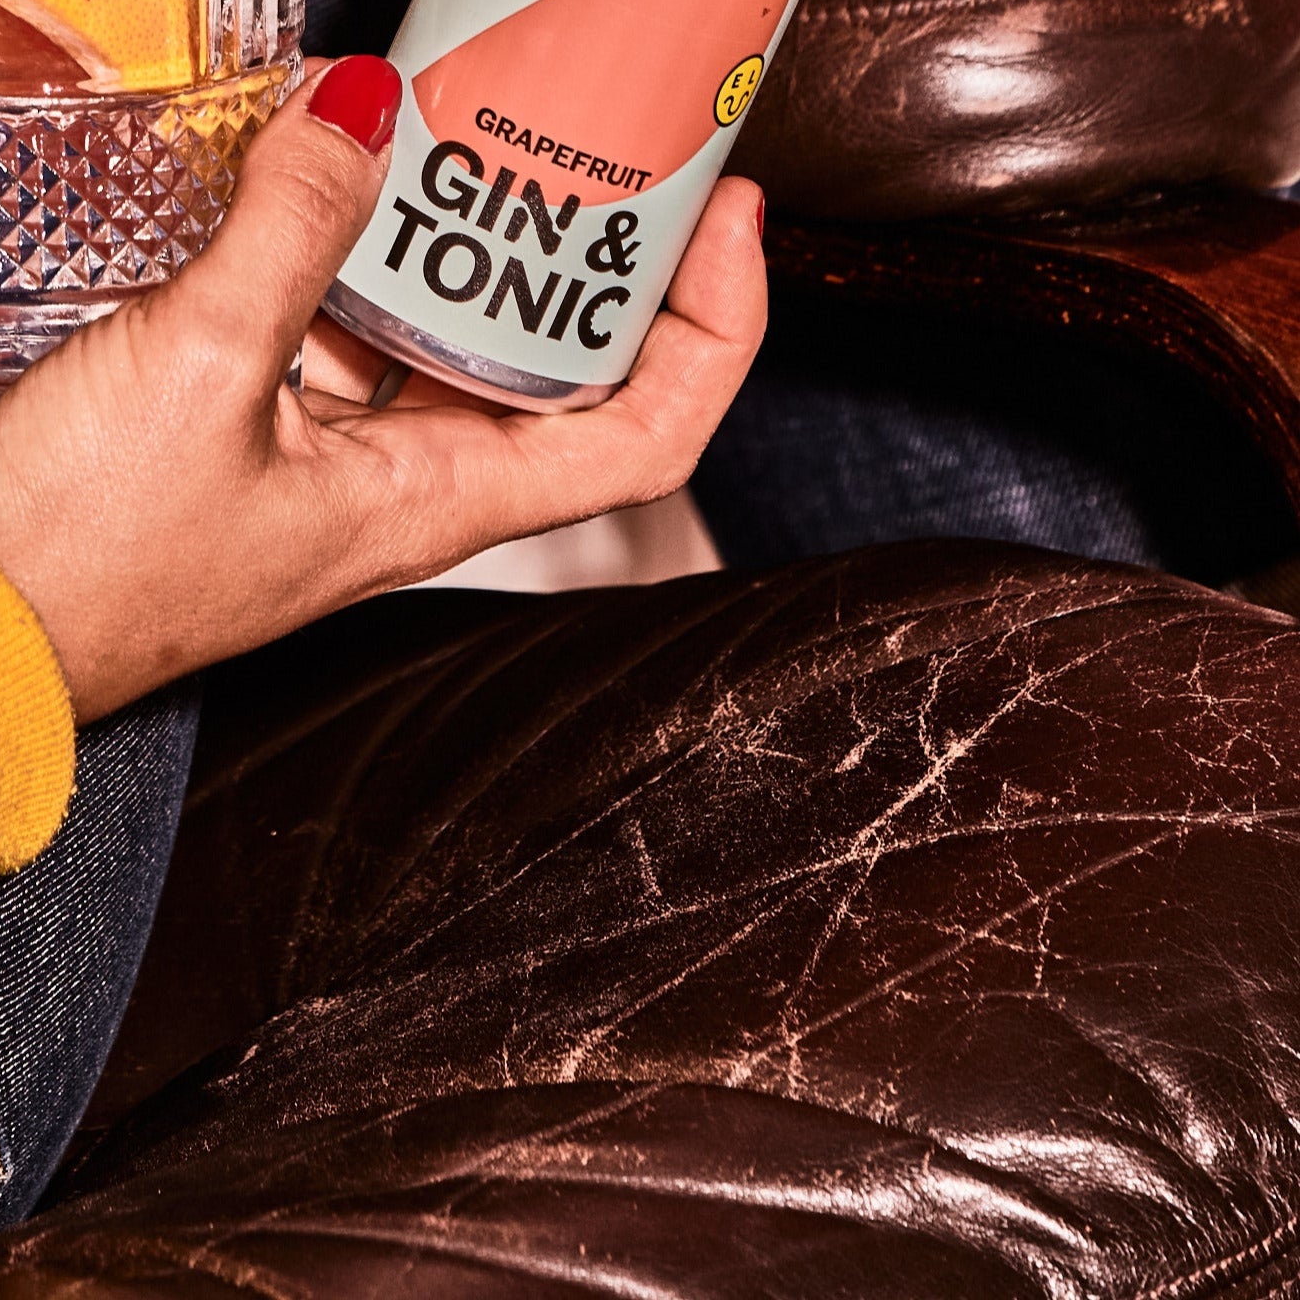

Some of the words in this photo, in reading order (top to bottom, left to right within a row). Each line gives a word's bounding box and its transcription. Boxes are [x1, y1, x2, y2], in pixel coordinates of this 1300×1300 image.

[420, 140, 581, 257] GIN
[584, 210, 642, 277] &
[474, 107, 653, 193] GRAPEFRUIT
[383, 196, 632, 351] TONIC
